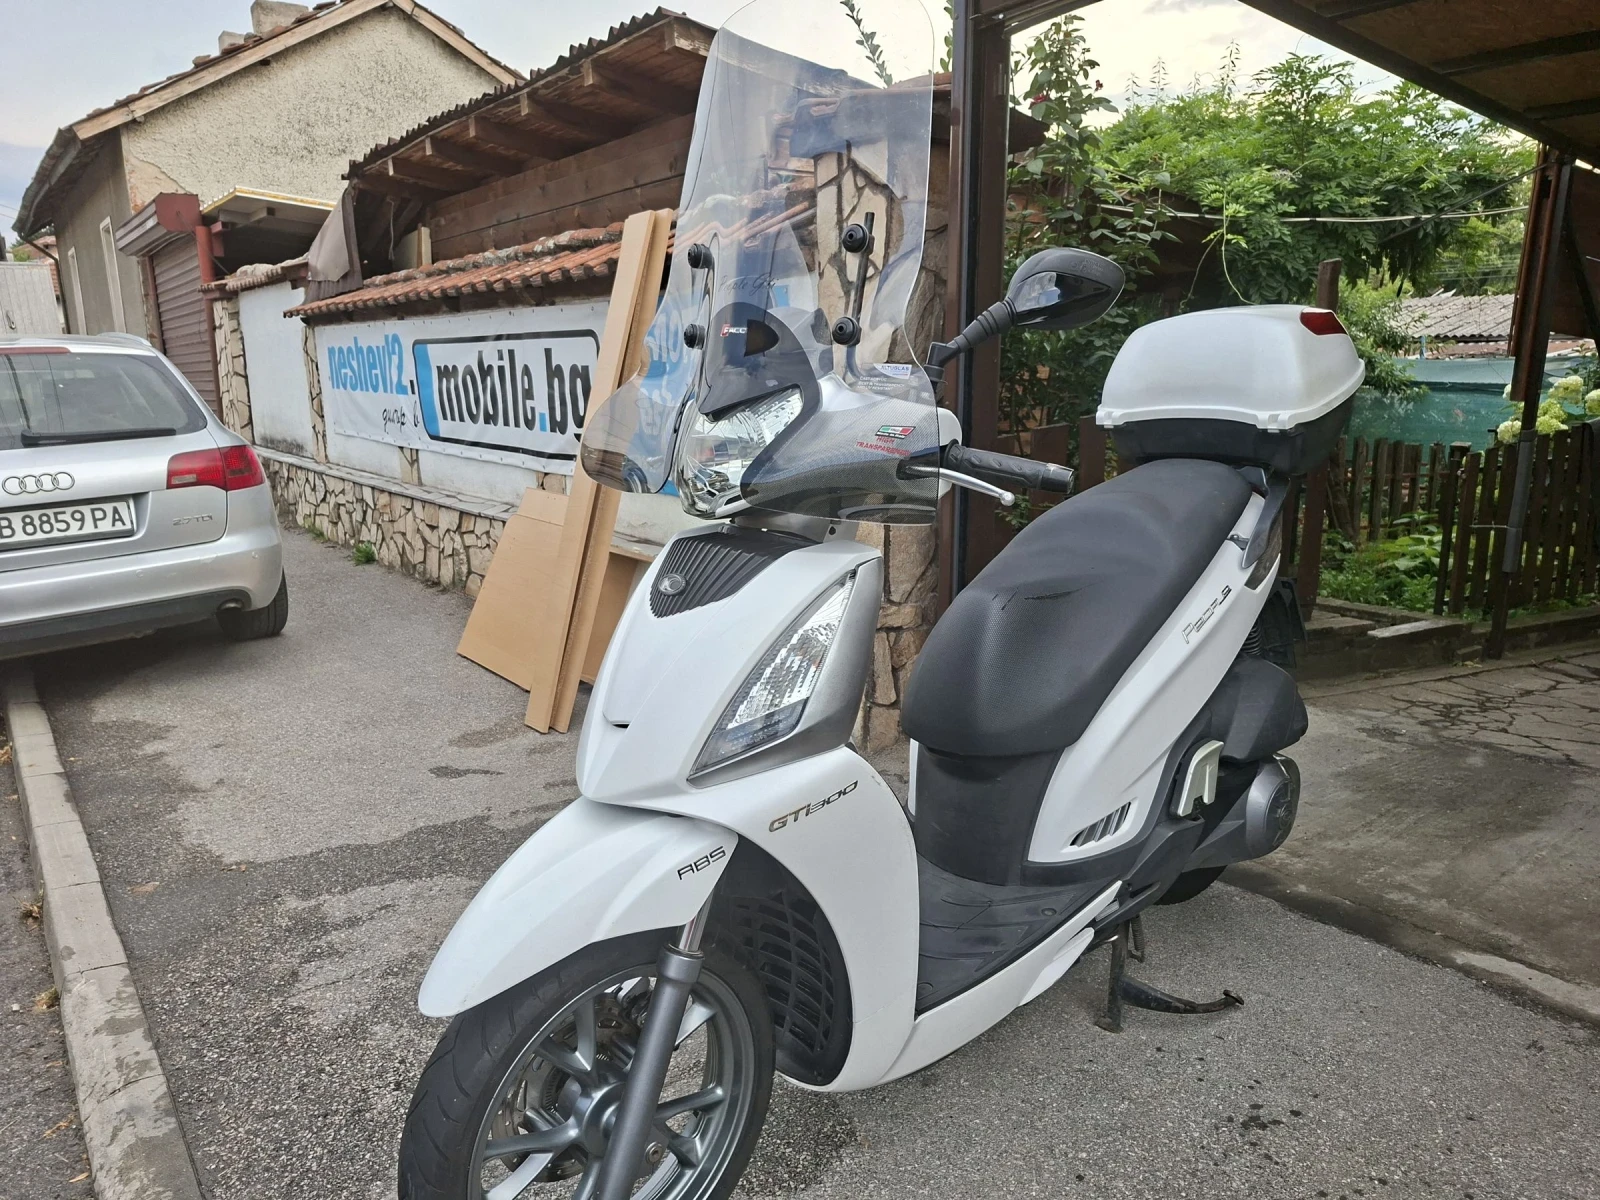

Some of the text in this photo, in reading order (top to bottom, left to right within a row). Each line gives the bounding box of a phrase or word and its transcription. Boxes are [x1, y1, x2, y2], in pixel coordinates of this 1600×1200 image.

[436, 348, 592, 443] mobile.bg
[21, 509, 86, 536] 8859
[90, 506, 127, 530] PA
[677, 845, 727, 881] ABS
